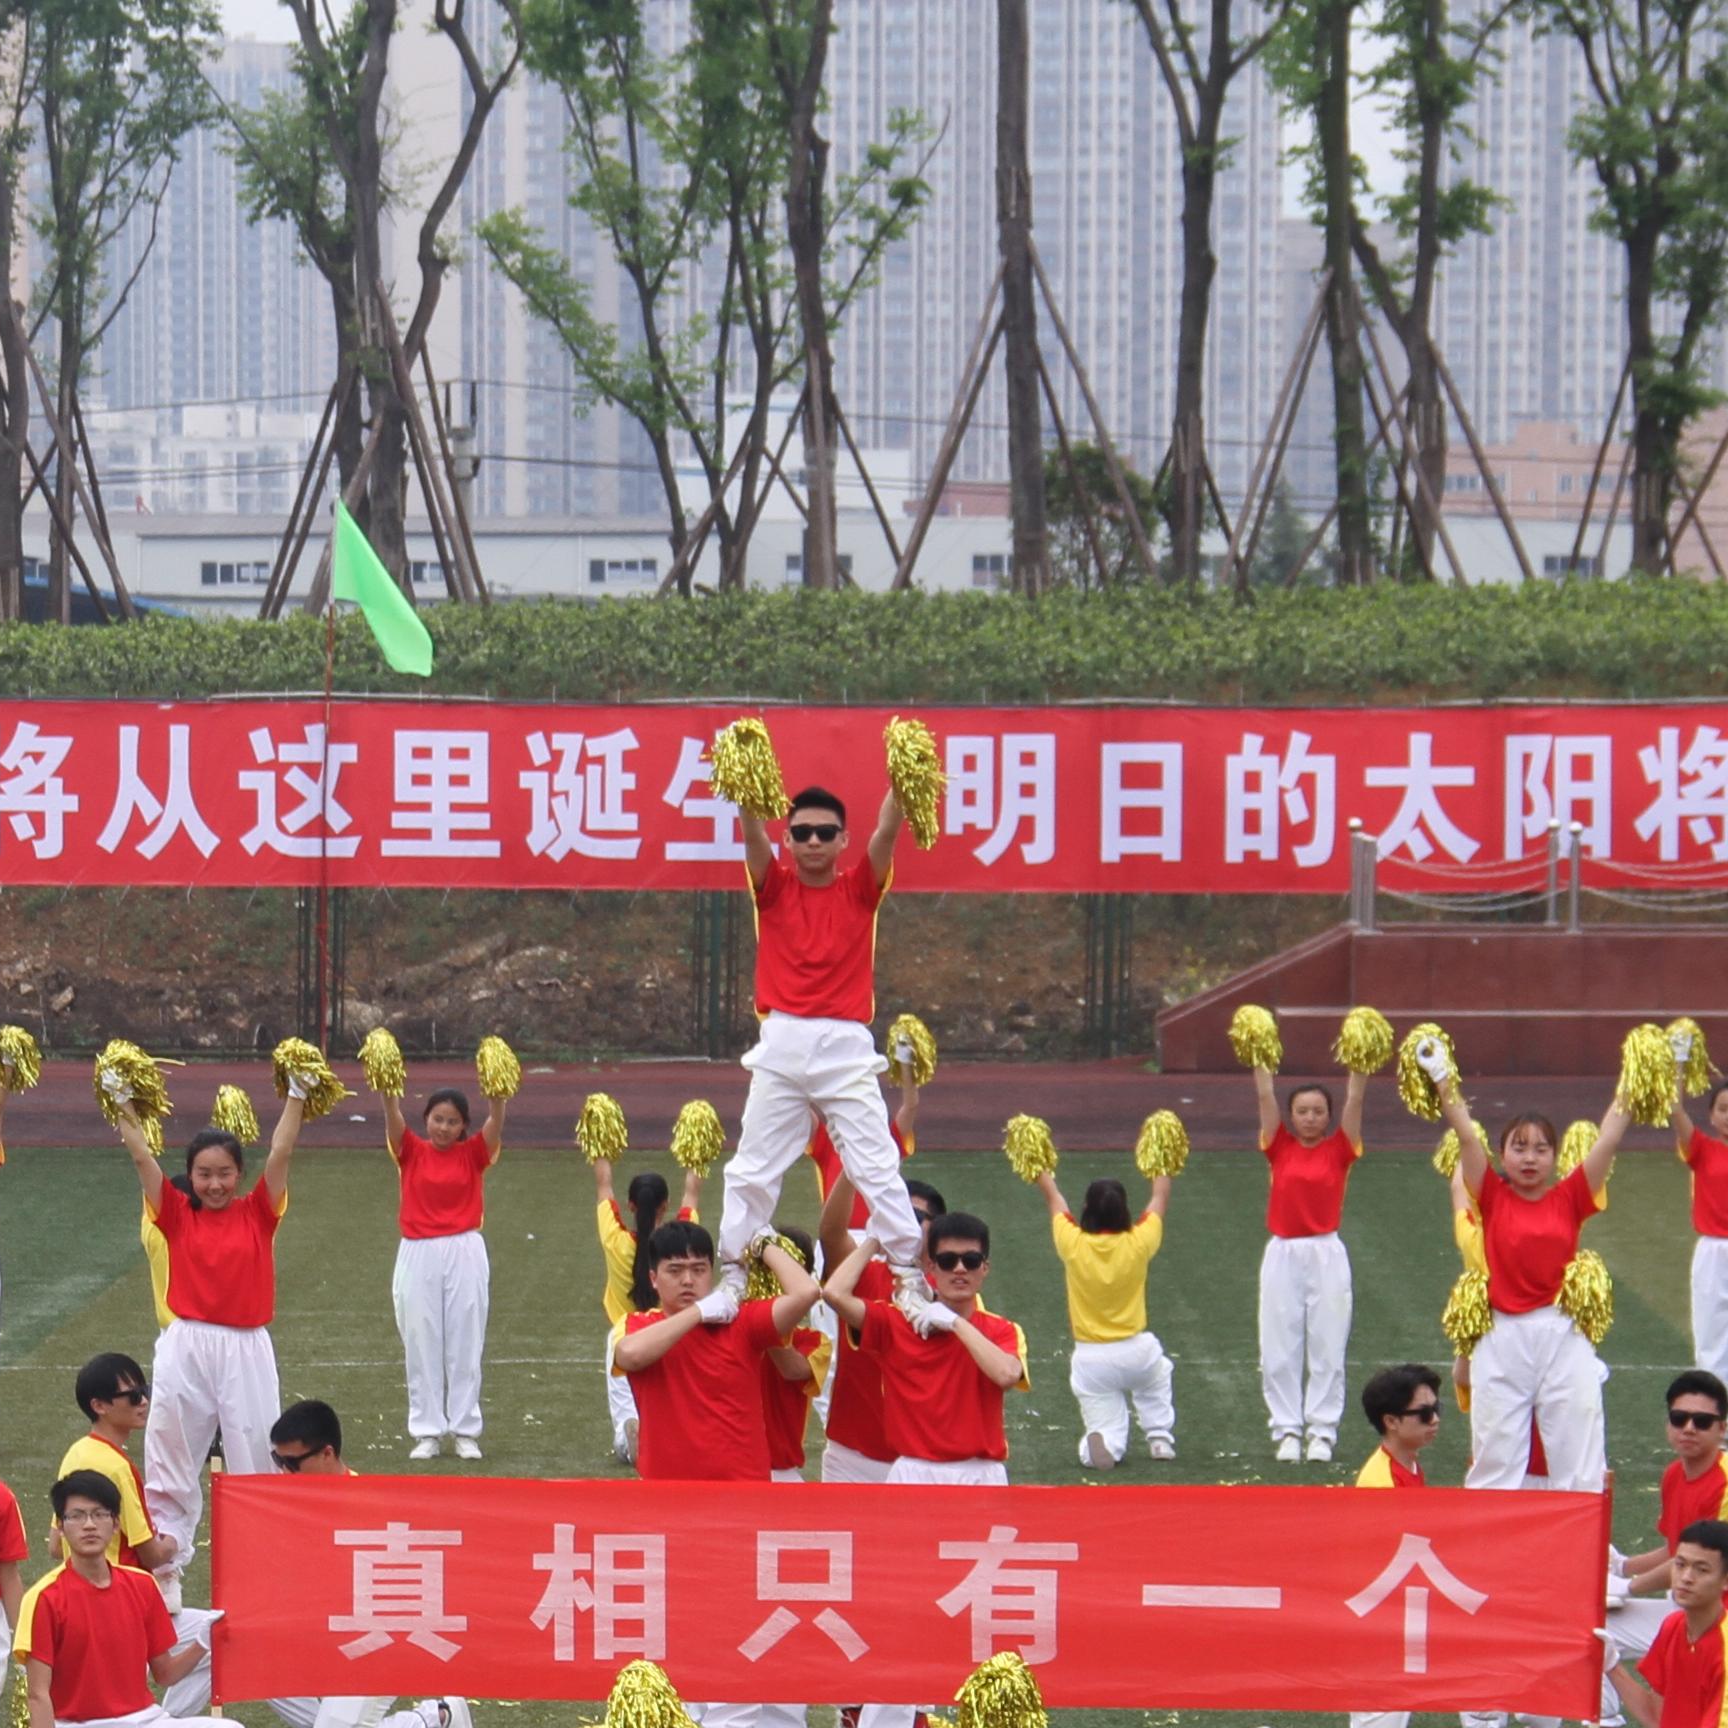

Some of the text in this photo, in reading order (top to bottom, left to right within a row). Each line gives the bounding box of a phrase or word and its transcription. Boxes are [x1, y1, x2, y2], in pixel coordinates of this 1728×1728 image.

[328, 1521, 1488, 1674] 真相只有一个
